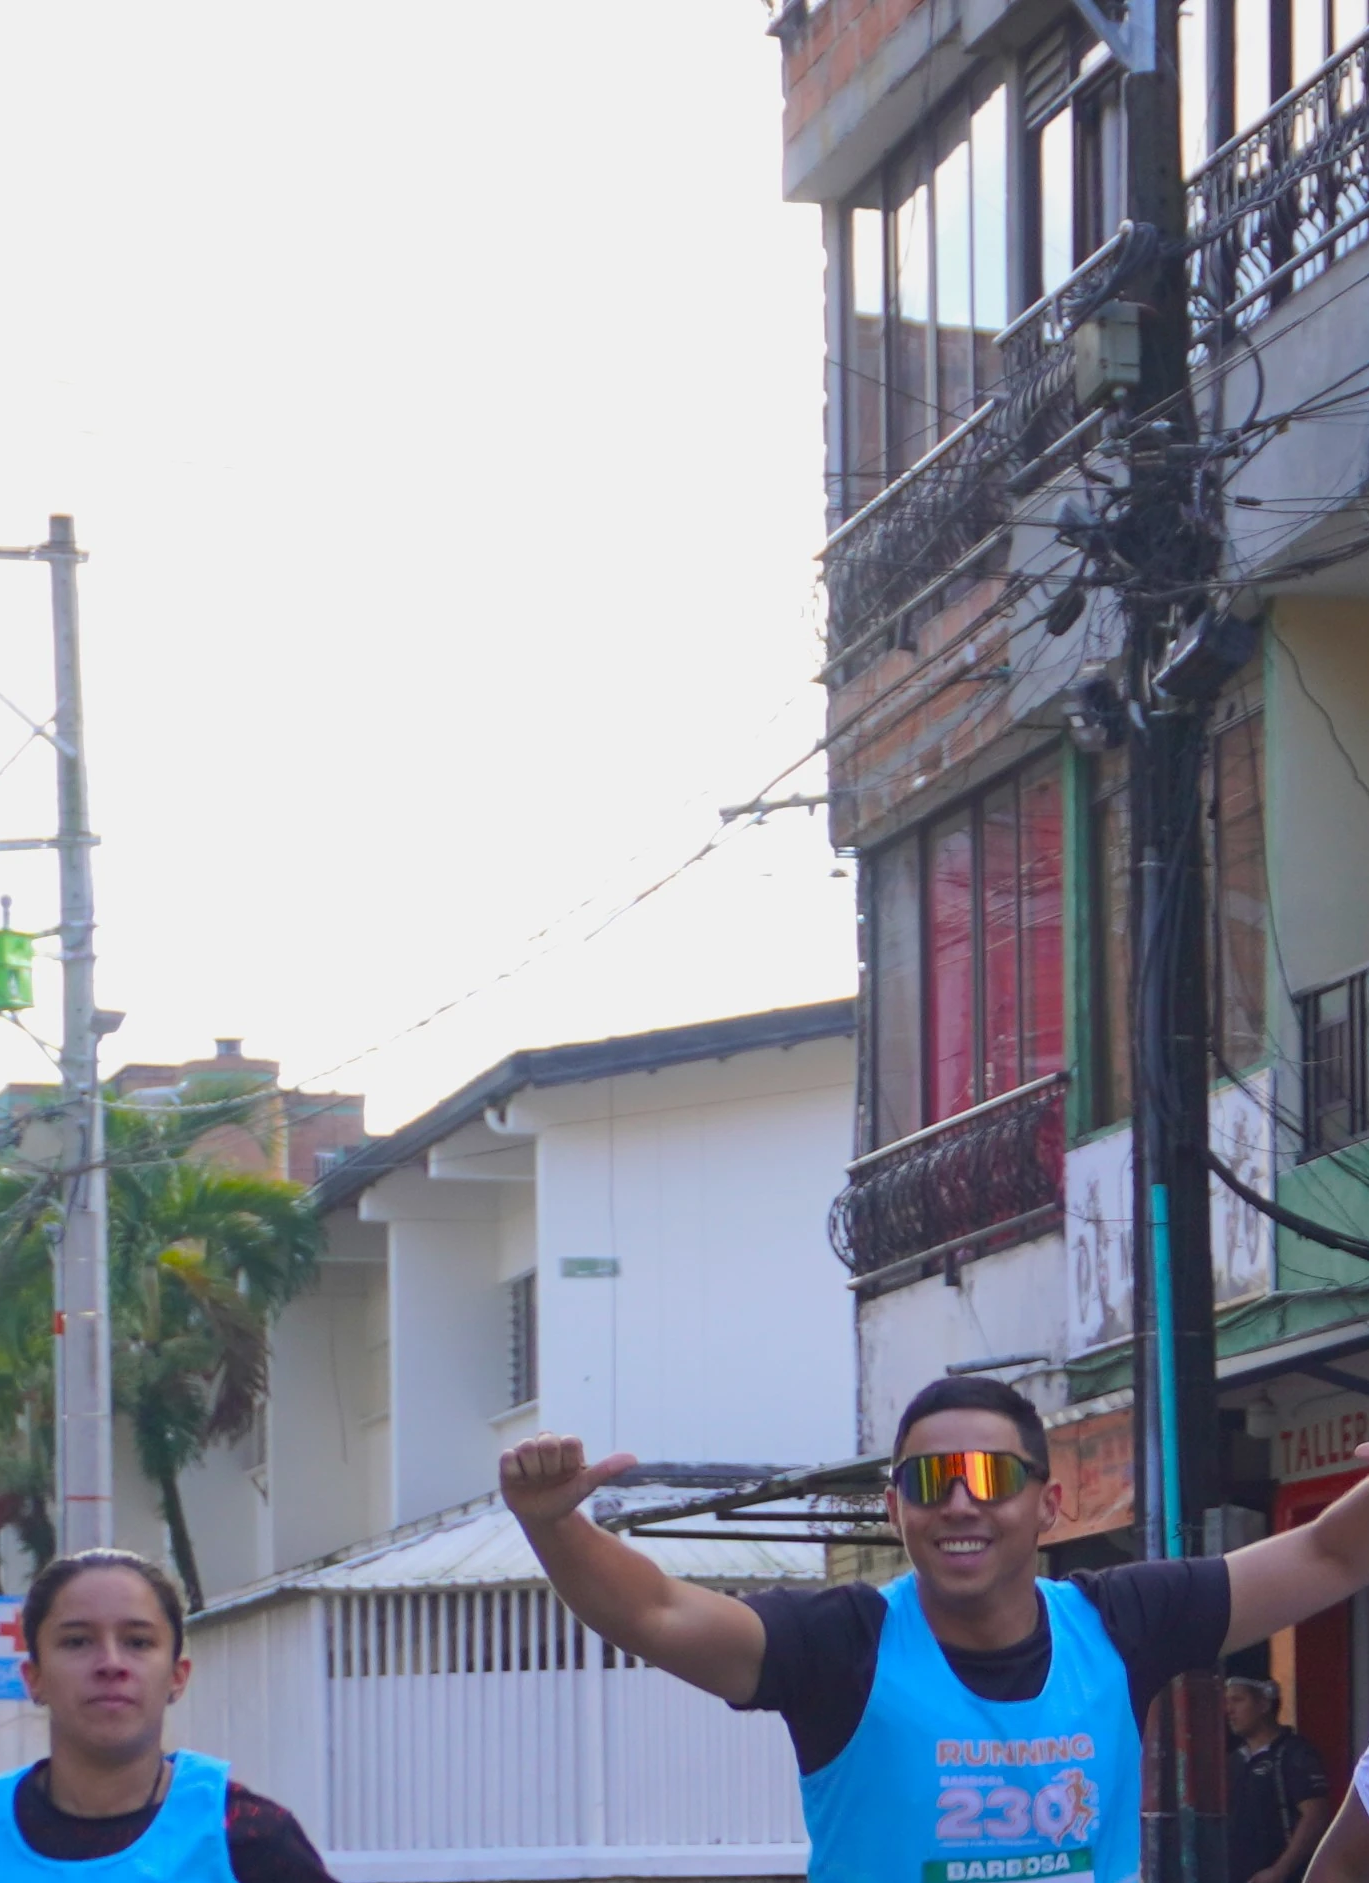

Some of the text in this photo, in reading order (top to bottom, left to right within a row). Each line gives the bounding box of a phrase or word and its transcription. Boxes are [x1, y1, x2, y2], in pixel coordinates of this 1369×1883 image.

[1280, 1411, 1366, 1474] TALLER
[936, 1733, 1095, 1766] RUNNING
[936, 1786, 1074, 1839] 230
[947, 1854, 1070, 1881] BARBOSA
